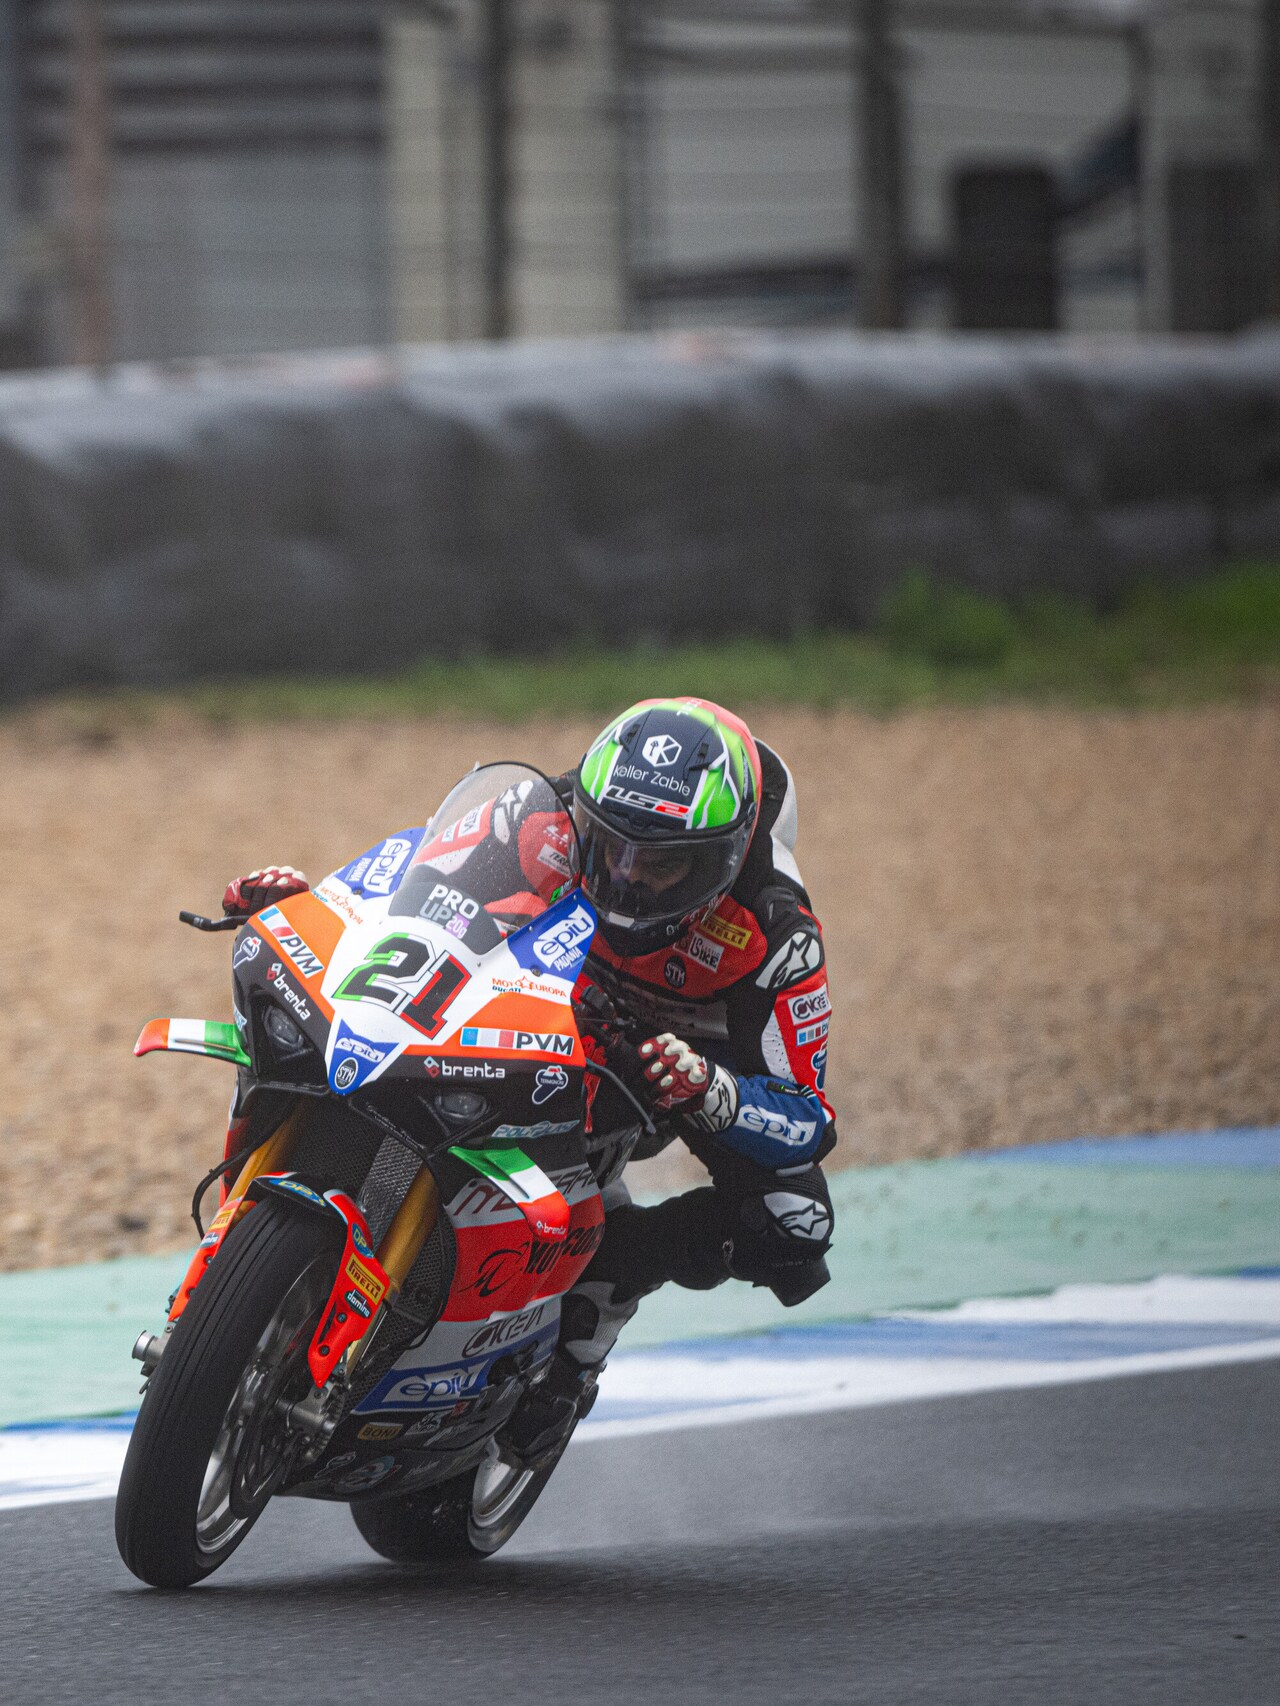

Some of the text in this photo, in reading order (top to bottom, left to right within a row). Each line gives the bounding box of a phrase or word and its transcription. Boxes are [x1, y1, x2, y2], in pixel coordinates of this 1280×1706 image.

[420, 900, 468, 939] UP 20g
[428, 884, 479, 920] PRO
[279, 935, 324, 975] PVM
[273, 973, 311, 1021] brenta
[331, 932, 472, 1040] 21
[516, 1032, 573, 1056] PVM
[337, 1066, 355, 1082] STM
[442, 1060, 505, 1079] brenta
[348, 1259, 381, 1299] PIRELLI
[346, 1288, 371, 1318] domino
